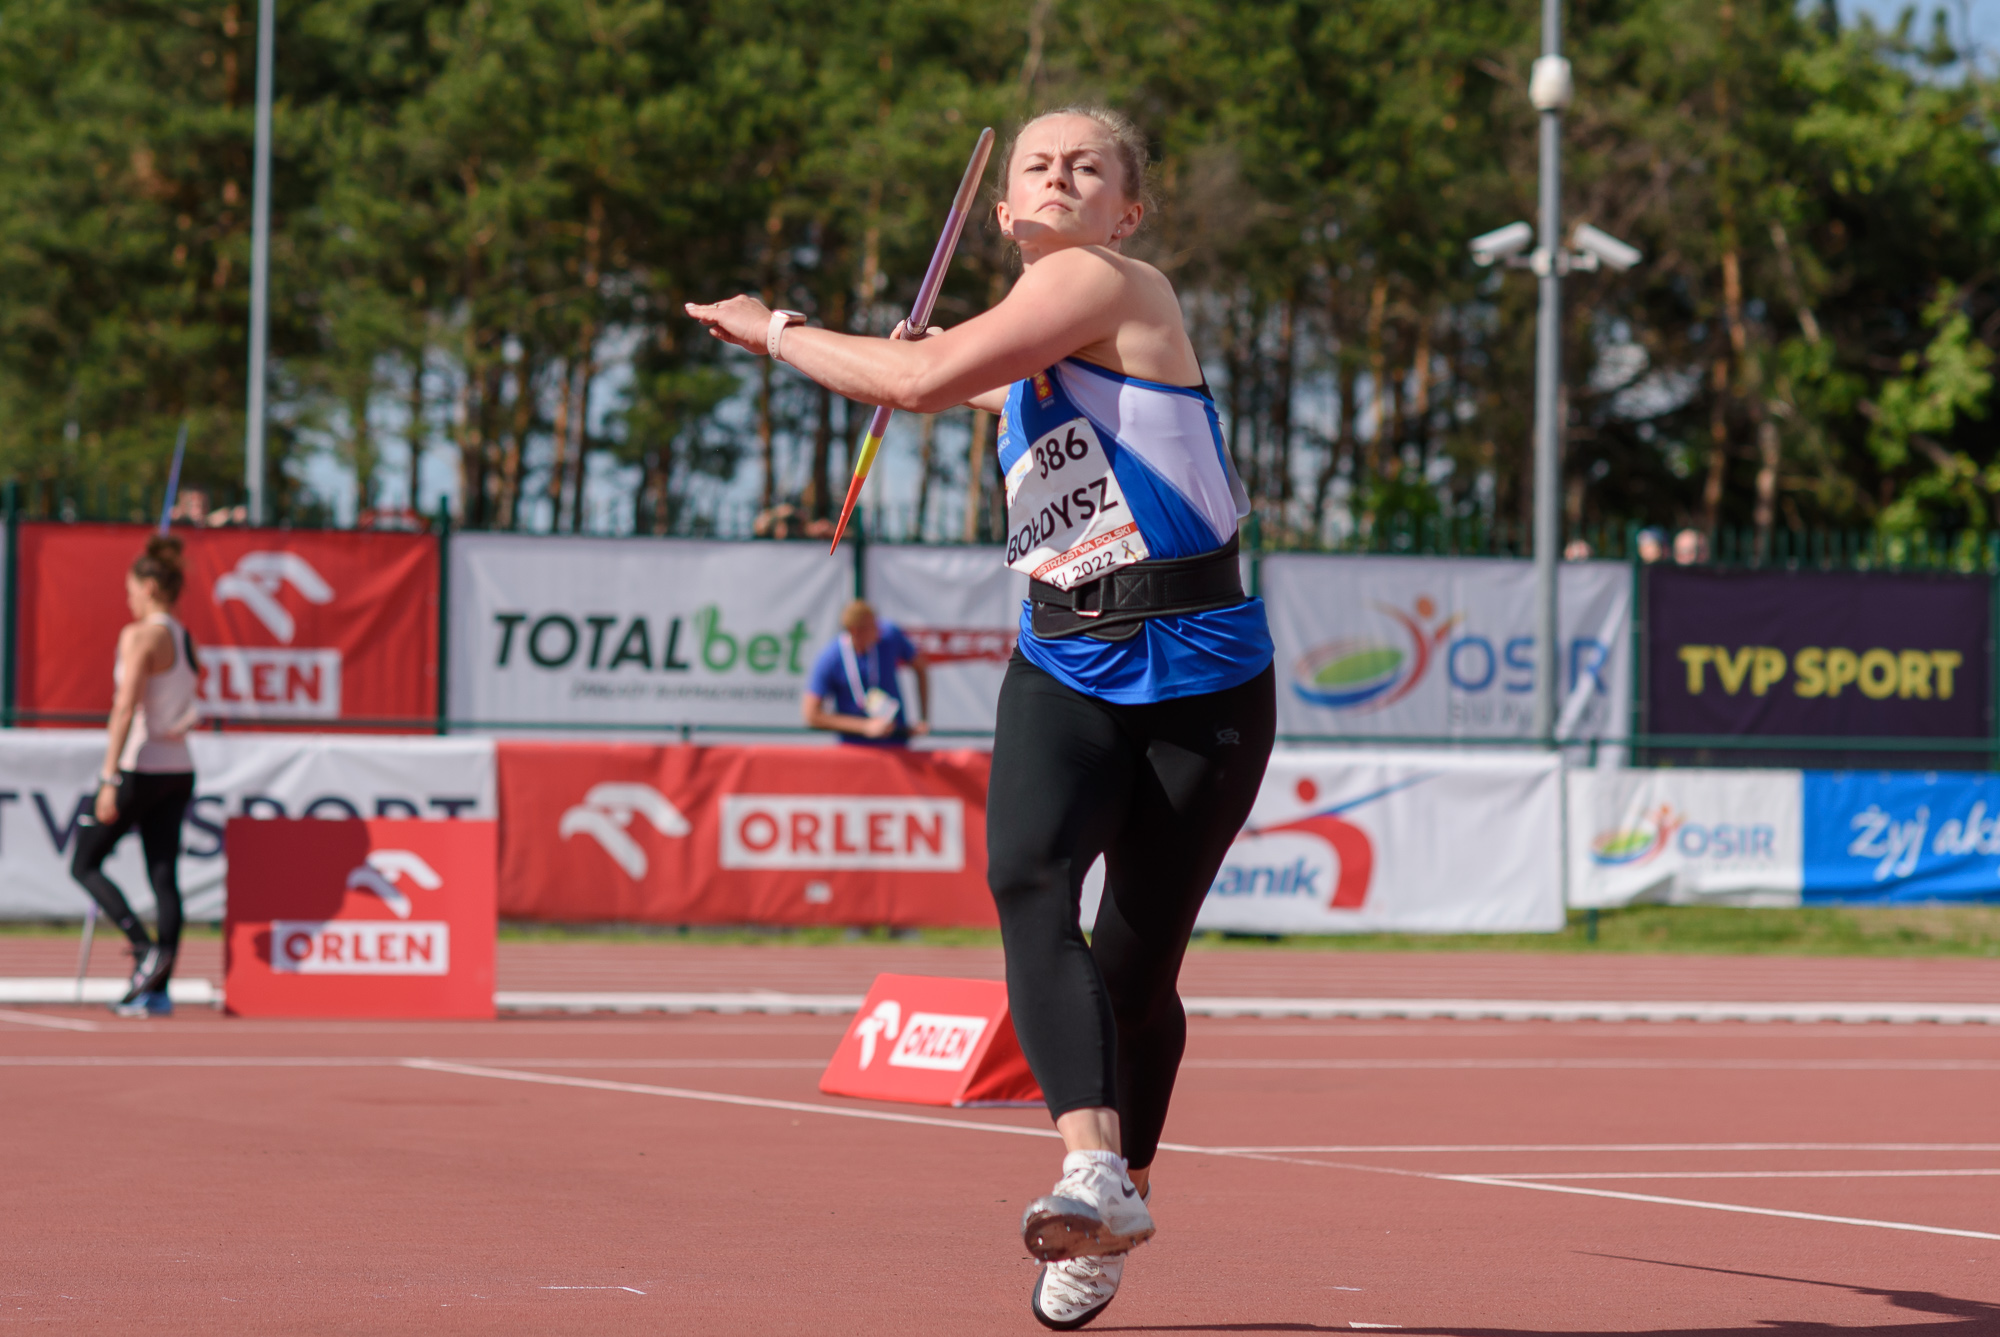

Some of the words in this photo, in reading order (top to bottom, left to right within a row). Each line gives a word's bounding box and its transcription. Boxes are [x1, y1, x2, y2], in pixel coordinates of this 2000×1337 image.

[1036, 427, 1088, 480] 386
[1007, 477, 1119, 566] BOŁDYSZ
[1095, 526, 1131, 547] POLSKI
[1072, 551, 1117, 581] 2022
[494, 603, 811, 675] TOTALbet
[1447, 637, 1609, 695] OSR
[1678, 645, 1787, 696] TVP
[1793, 647, 1963, 700] SPORT
[740, 811, 942, 855] ORLEN
[1678, 823, 1775, 859] OSIR
[1209, 856, 1321, 896] anik
[284, 933, 432, 964] ORLEN
[903, 1025, 979, 1058] ORLEN
